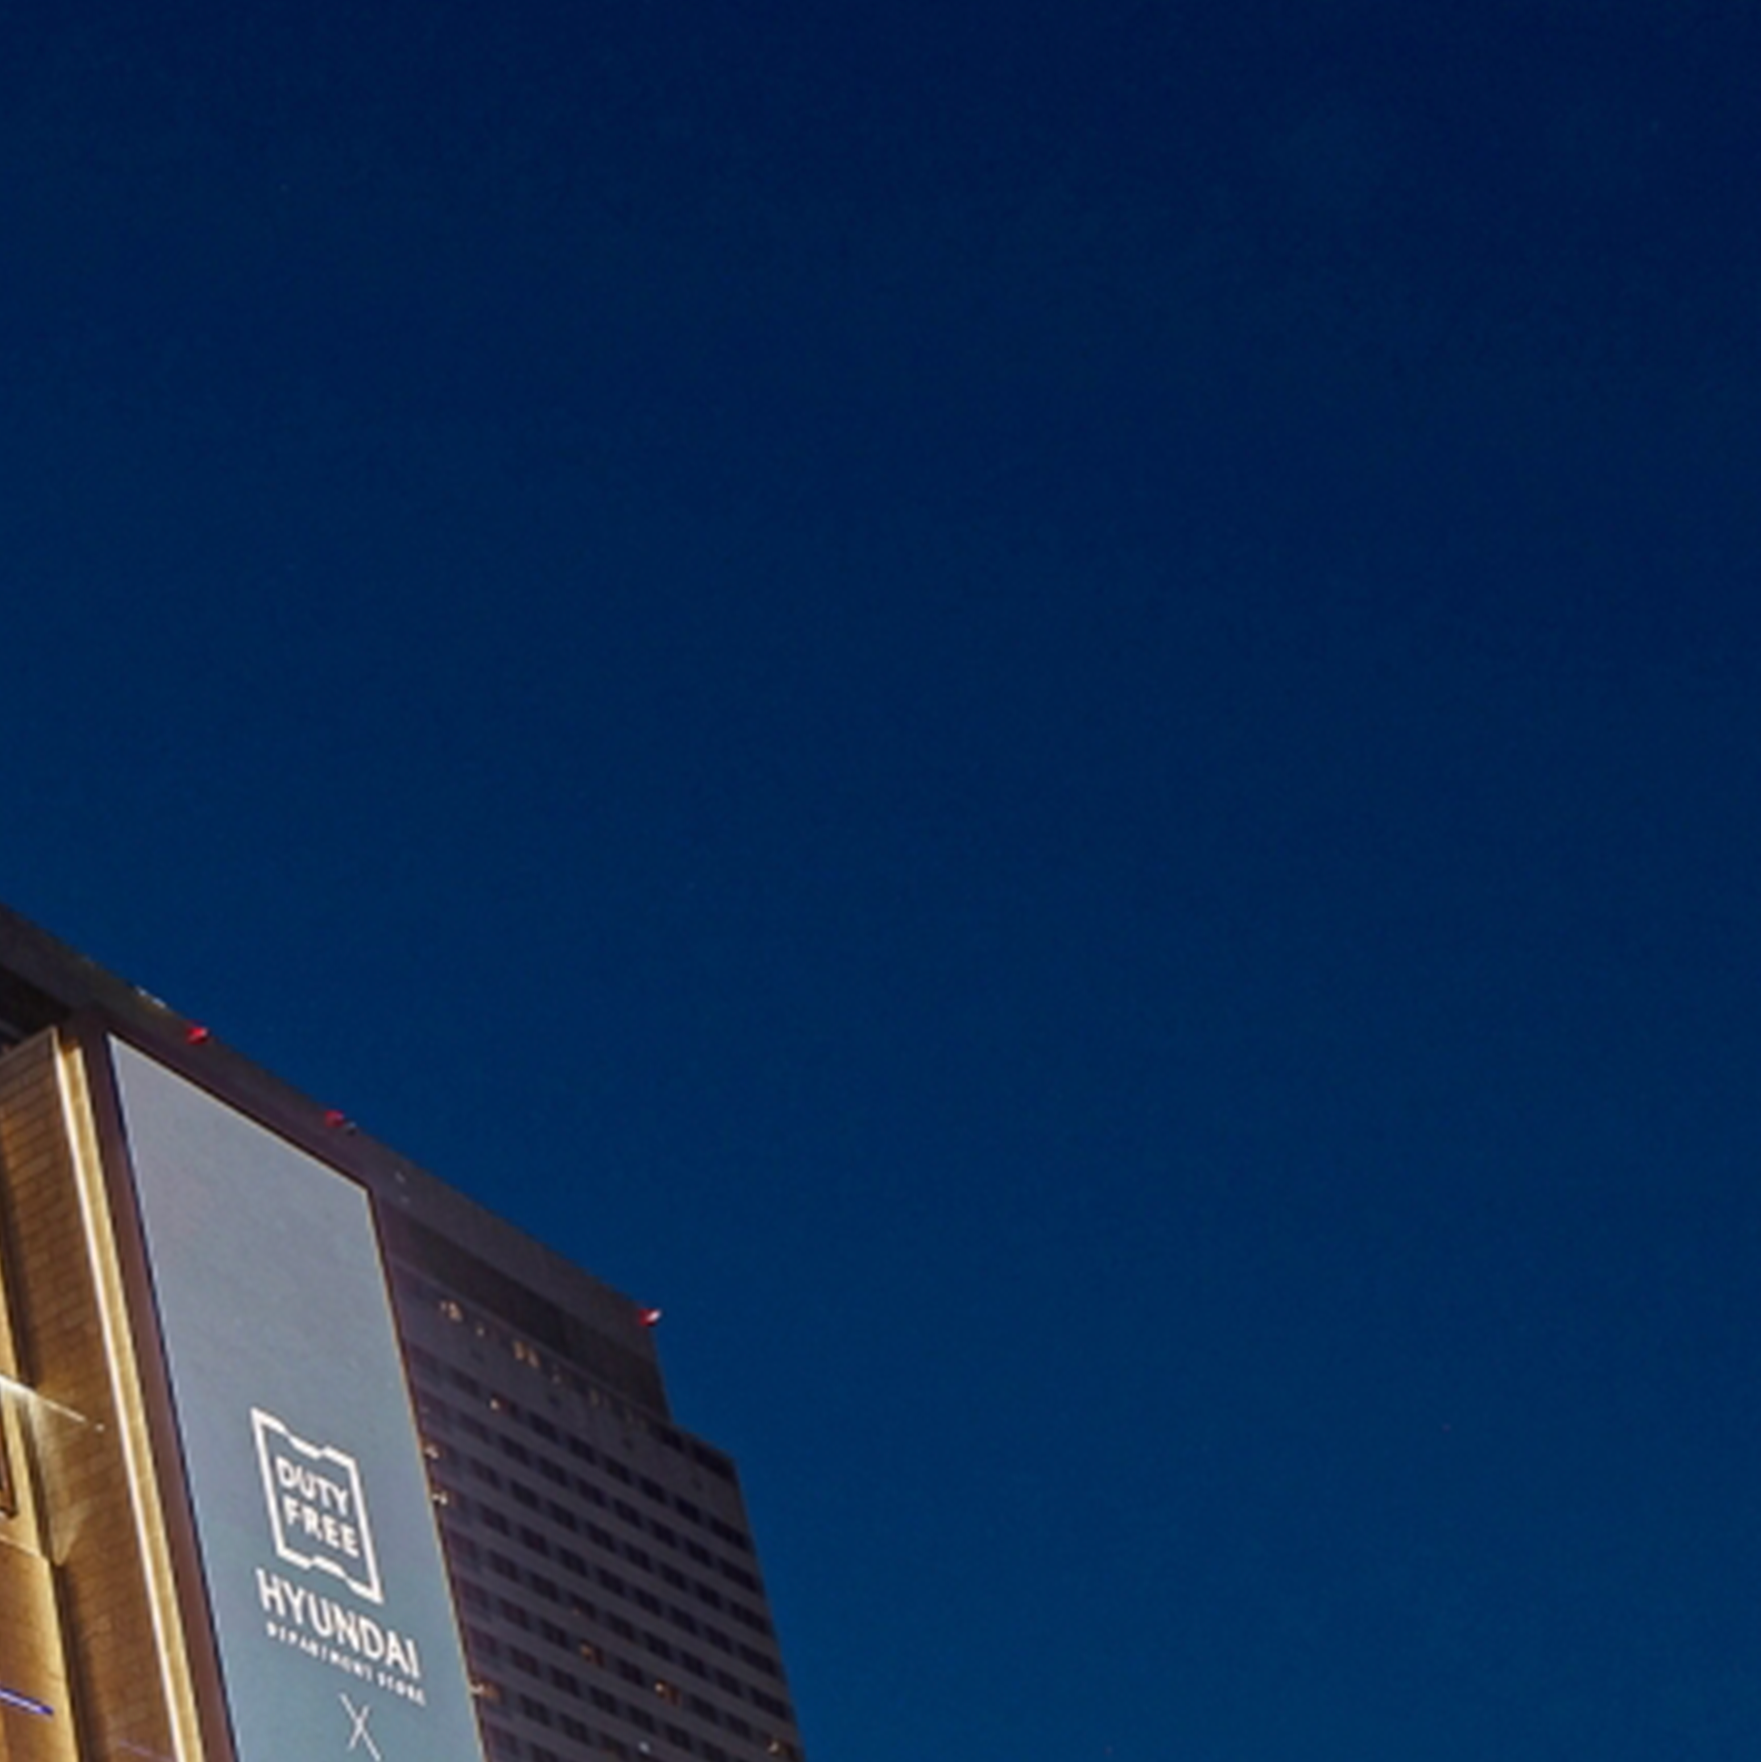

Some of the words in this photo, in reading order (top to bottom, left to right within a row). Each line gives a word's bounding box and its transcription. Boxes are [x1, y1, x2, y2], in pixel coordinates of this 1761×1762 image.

[276, 1456, 348, 1516] DUTY
[283, 1495, 359, 1558] FREE
[255, 1568, 421, 1679] HYUNDAI
